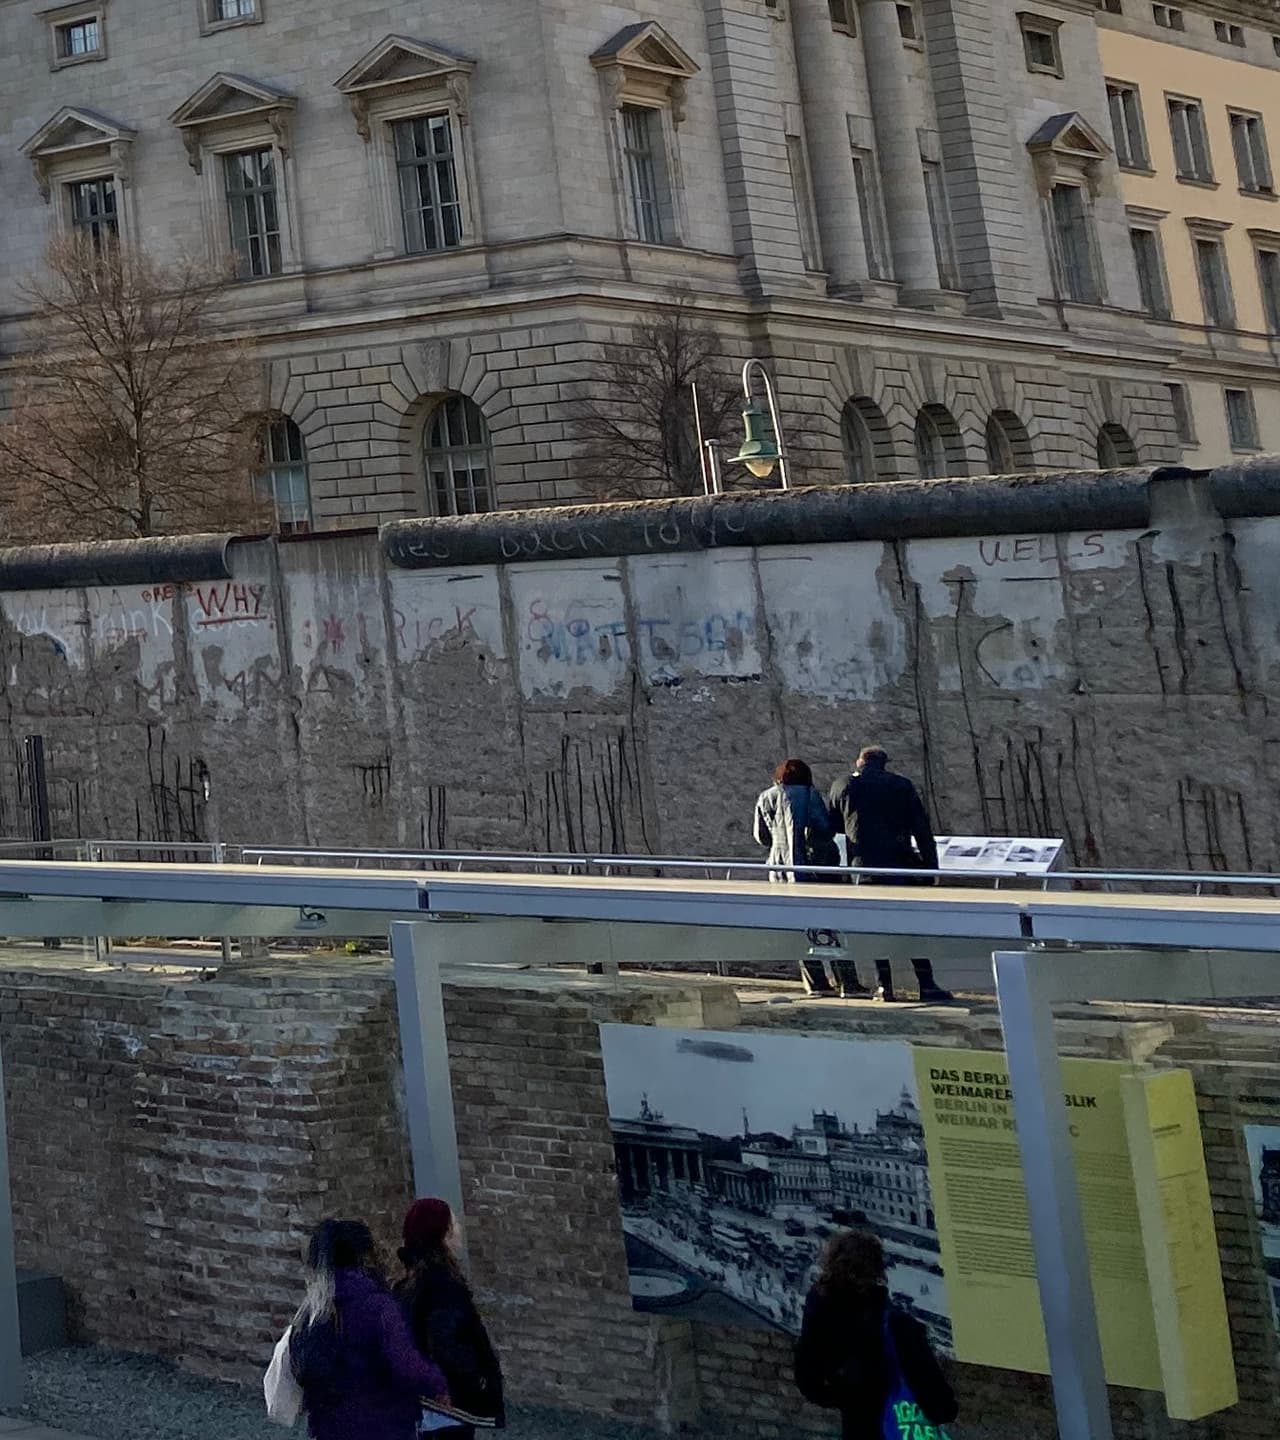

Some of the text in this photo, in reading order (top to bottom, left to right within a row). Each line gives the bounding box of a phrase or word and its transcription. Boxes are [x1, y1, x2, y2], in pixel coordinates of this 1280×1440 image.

[195, 582, 265, 616] WHY
[930, 1068, 1010, 1085] DAS BERLI
[933, 1098, 1008, 1116] BERLIN IN
[935, 1113, 998, 1131] WEIMAR
